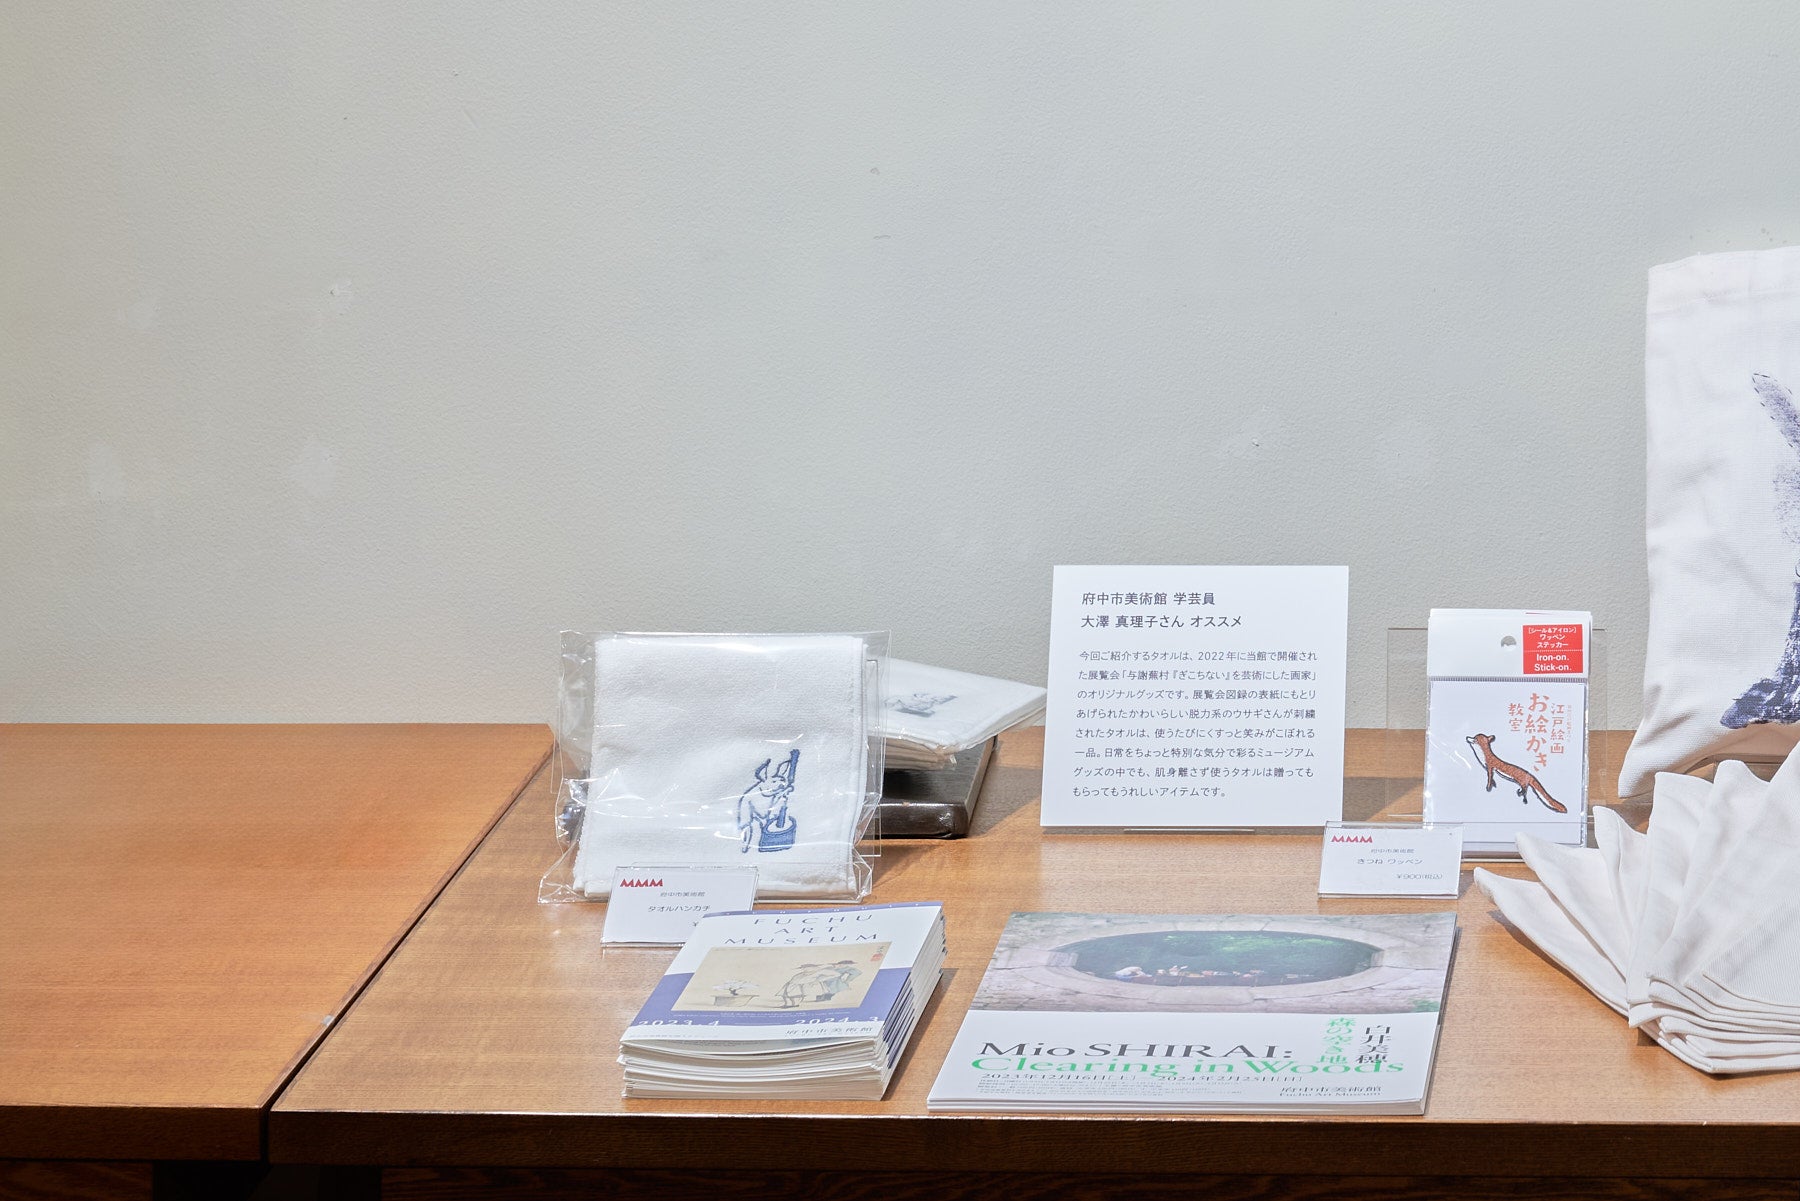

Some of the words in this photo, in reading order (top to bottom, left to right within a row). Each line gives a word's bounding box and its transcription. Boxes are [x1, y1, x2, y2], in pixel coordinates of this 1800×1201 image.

[1082, 592, 1167, 605] 府中市美術館
[1173, 592, 1215, 605] 学芸員
[1081, 615, 1109, 628] 大澤
[1115, 615, 1184, 628] 真理子さん
[1190, 616, 1241, 627] オススメ
[1539, 633, 1566, 641] ワッペン
[1537, 641, 1569, 649] ステッカー
[1080, 651, 1317, 661] 今回ご紹介するタオルは、2022年に当館で開催され
[1536, 653, 1570, 662] Iron-on.
[1534, 662, 1572, 672] Stick-on.
[1079, 670, 1315, 680] た展覧会「与謝蕪村『ぎこちない』を芸術にした画家」
[1078, 689, 1315, 700] のオリジナルグッズです。展覧会図録の表紙にもとり
[1508, 703, 1523, 731] 教室
[1076, 728, 1314, 738] されたタオルは、使うたびにくすっと笑みがこぼれる
[1524, 693, 1549, 773] お絵かき
[1551, 704, 1565, 753] 江戸絵画
[1075, 746, 1314, 758] 一品。日常をちょっと特別な気分で彩るミュージアム
[1074, 767, 1313, 777] グッズの中でも、肌身離さず使うタオルは贈っても
[1073, 787, 1225, 797] もらってもうれしいアイテムです。
[976, 1042, 1076, 1057] Mio
[1084, 1043, 1294, 1059] SHIRAI:
[971, 1057, 1180, 1078] Clearing
[1193, 1059, 1235, 1073] in
[1243, 1059, 1404, 1074] Woods
